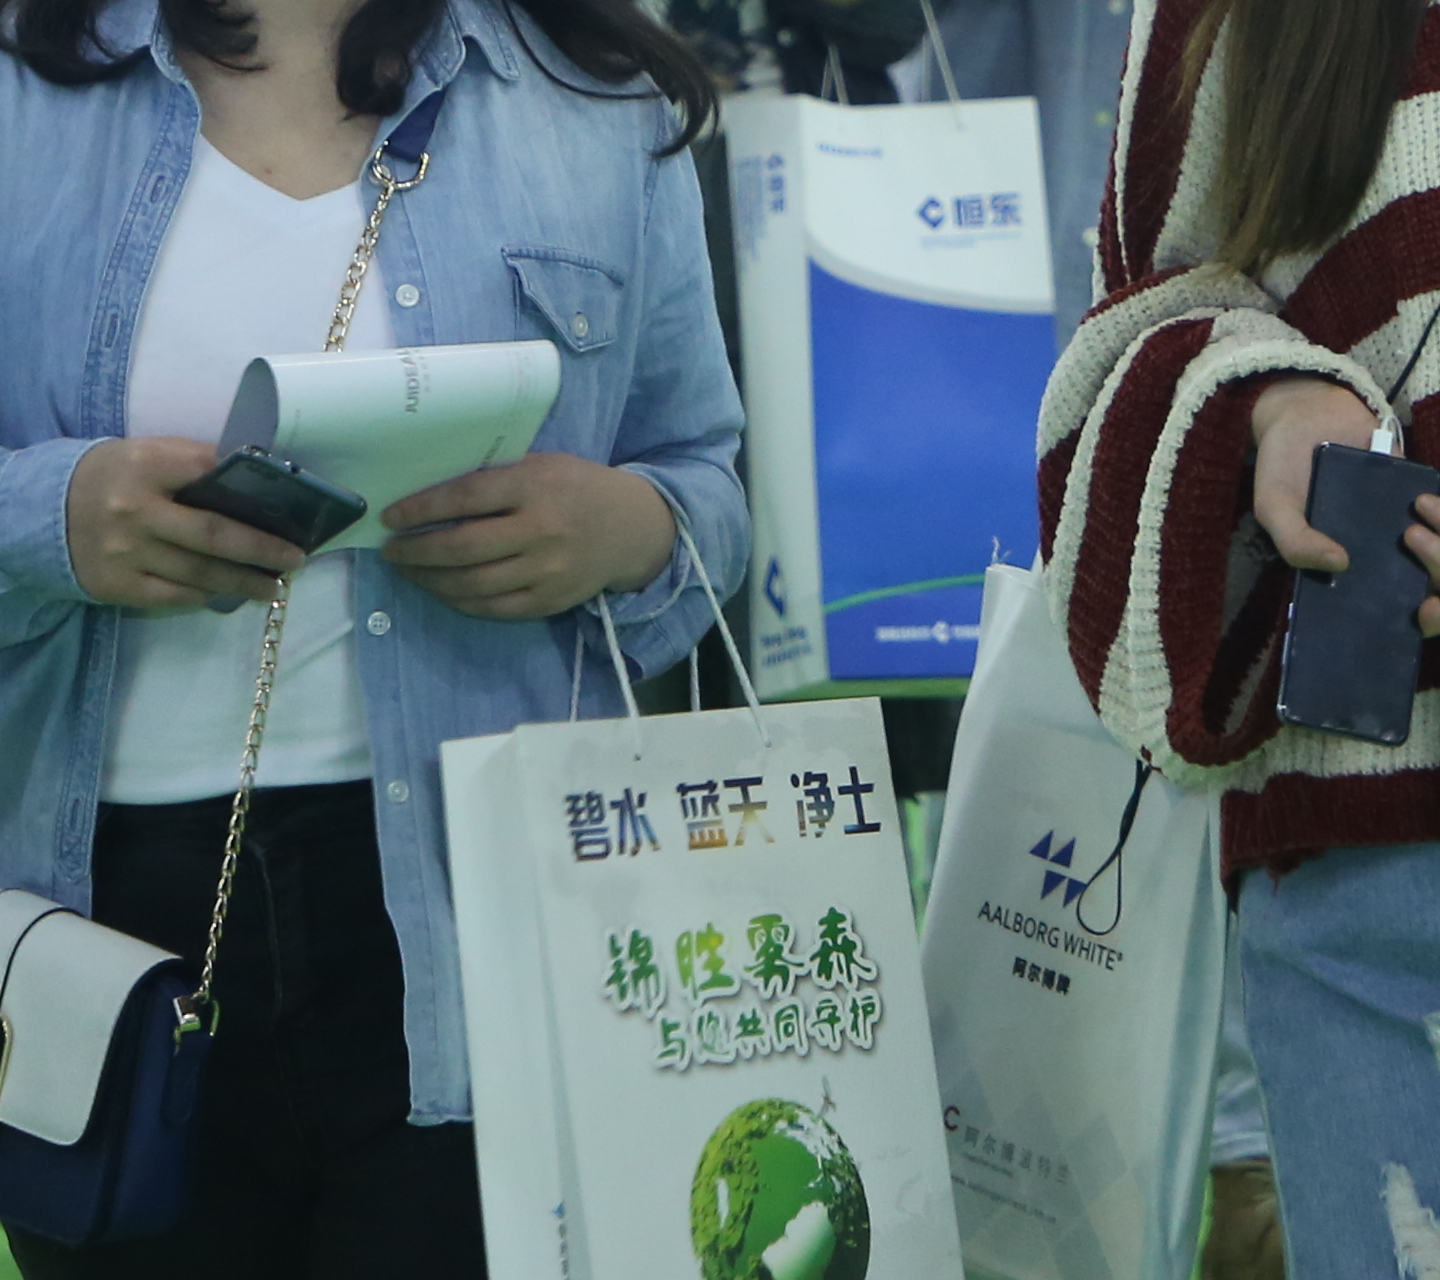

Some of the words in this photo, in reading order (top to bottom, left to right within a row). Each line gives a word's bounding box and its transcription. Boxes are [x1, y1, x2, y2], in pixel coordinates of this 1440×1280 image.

[563, 786, 661, 862] 碧水
[675, 776, 775, 851] 蓝天
[789, 765, 881, 838] 净土
[977, 900, 1061, 948] AALBORG
[656, 994, 878, 1068] 与您共同守护
